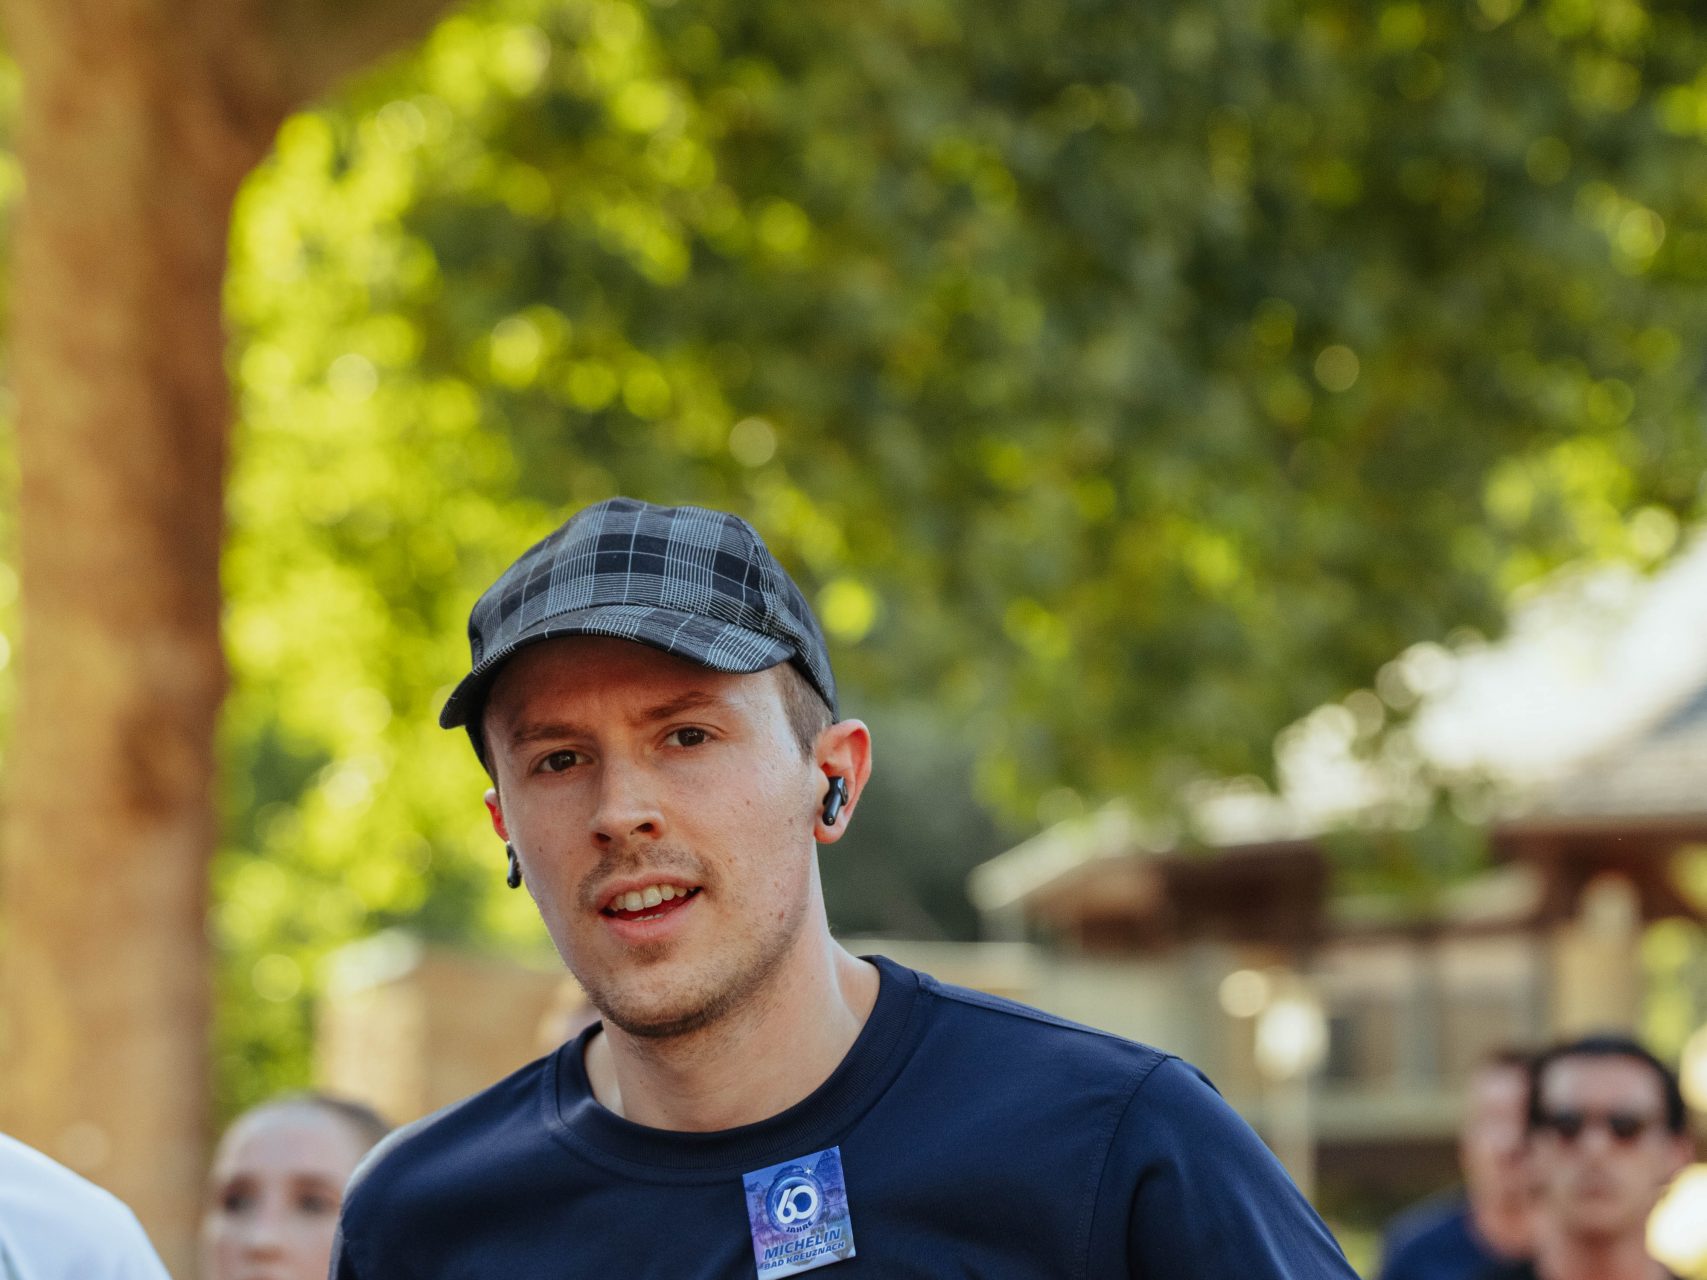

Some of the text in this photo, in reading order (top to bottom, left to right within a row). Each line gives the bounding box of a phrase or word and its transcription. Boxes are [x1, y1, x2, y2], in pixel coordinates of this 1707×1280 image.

[777, 1185, 818, 1224] 60
[764, 1228, 841, 1260] MICHELIN
[786, 1241, 845, 1264] KREUZNACH
